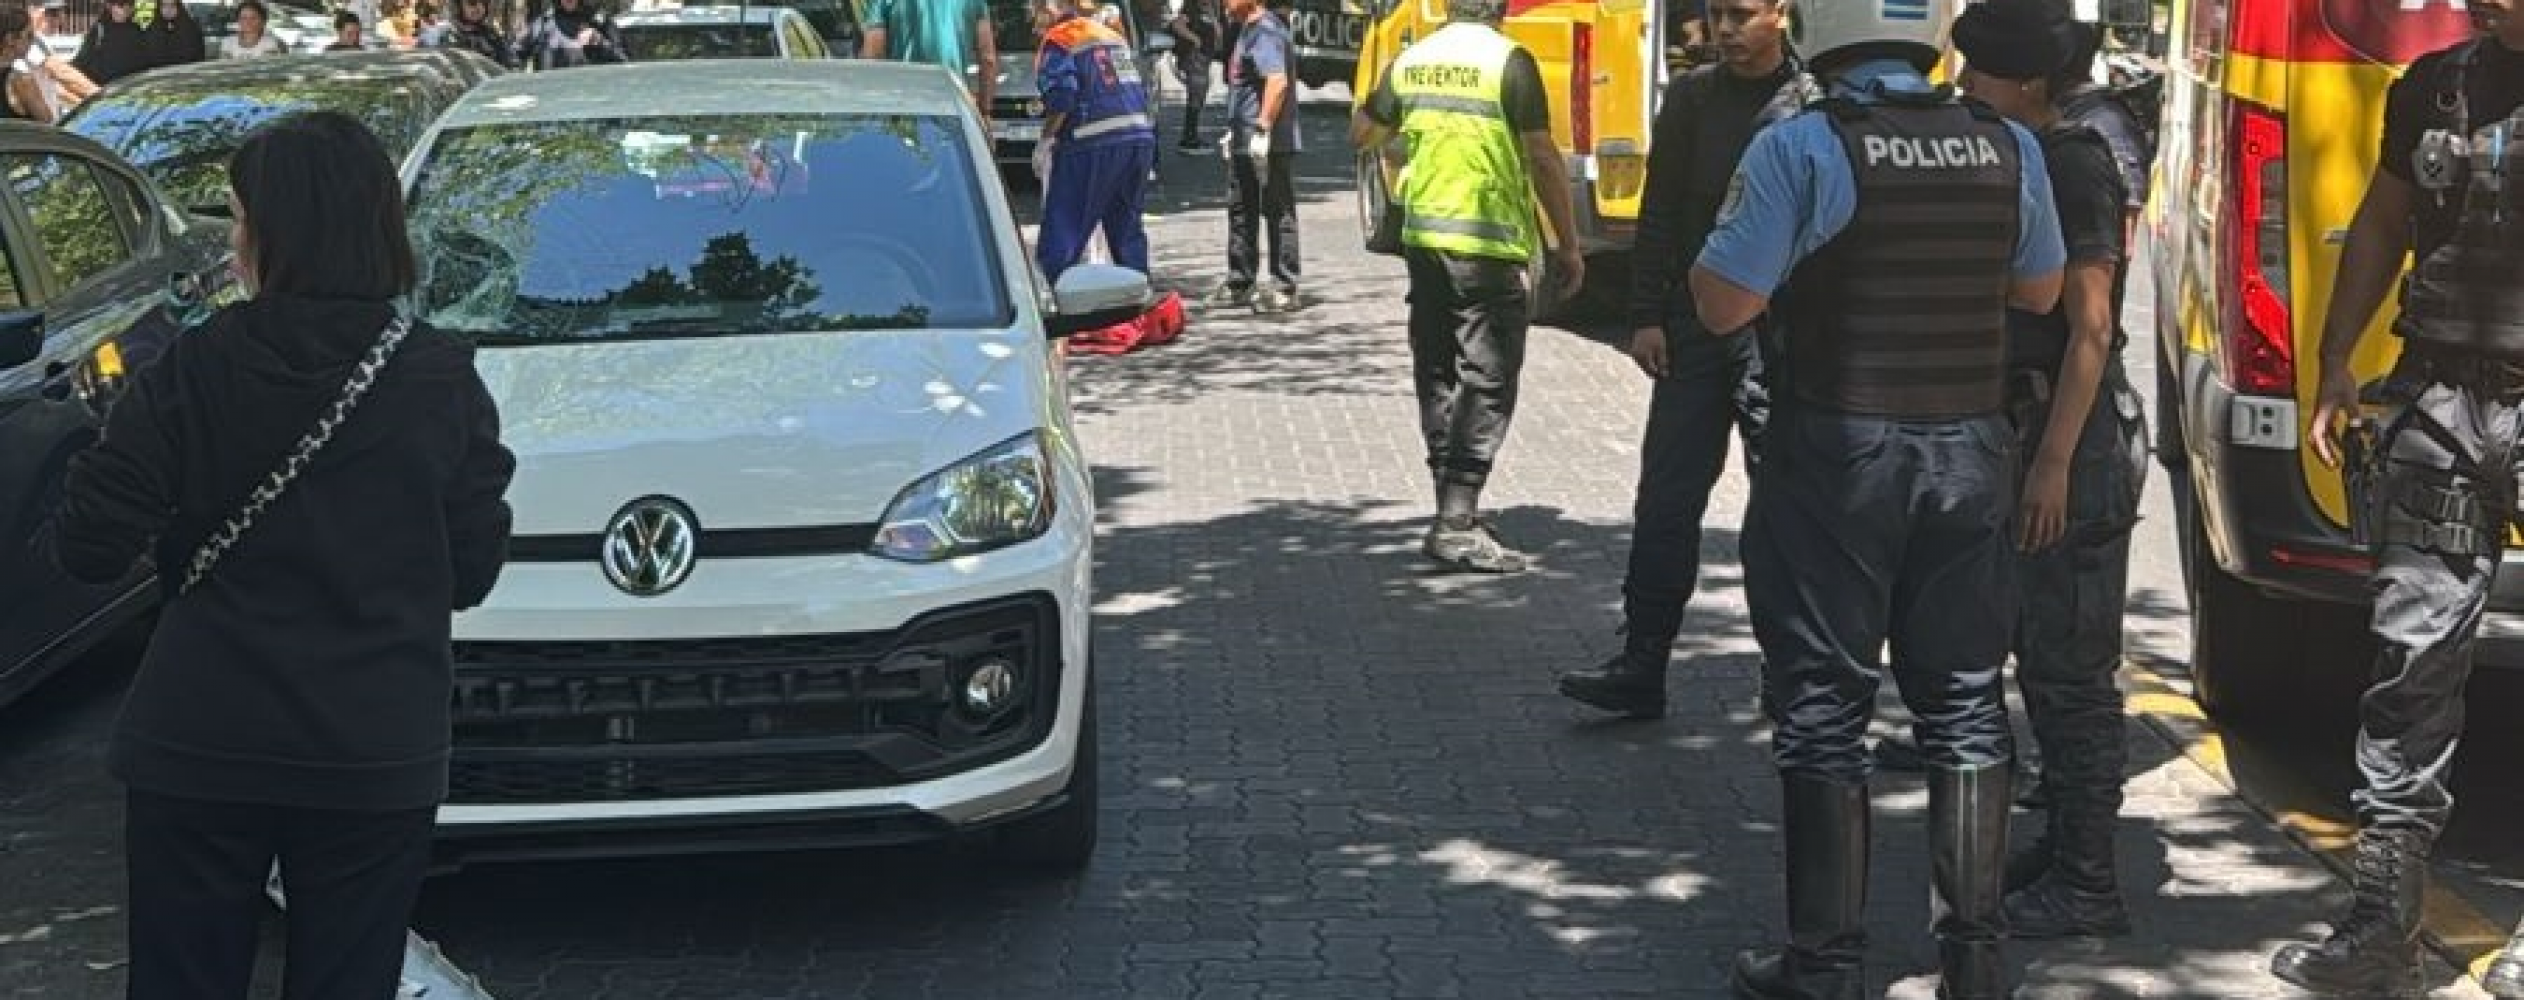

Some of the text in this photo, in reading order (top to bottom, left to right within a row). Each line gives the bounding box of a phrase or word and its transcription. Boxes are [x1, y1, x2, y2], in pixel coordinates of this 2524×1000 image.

[1289, 10, 1362, 48] POLIC
[1404, 64, 1481, 88] PREVENTOR
[1862, 134, 2000, 168] POLICIA
